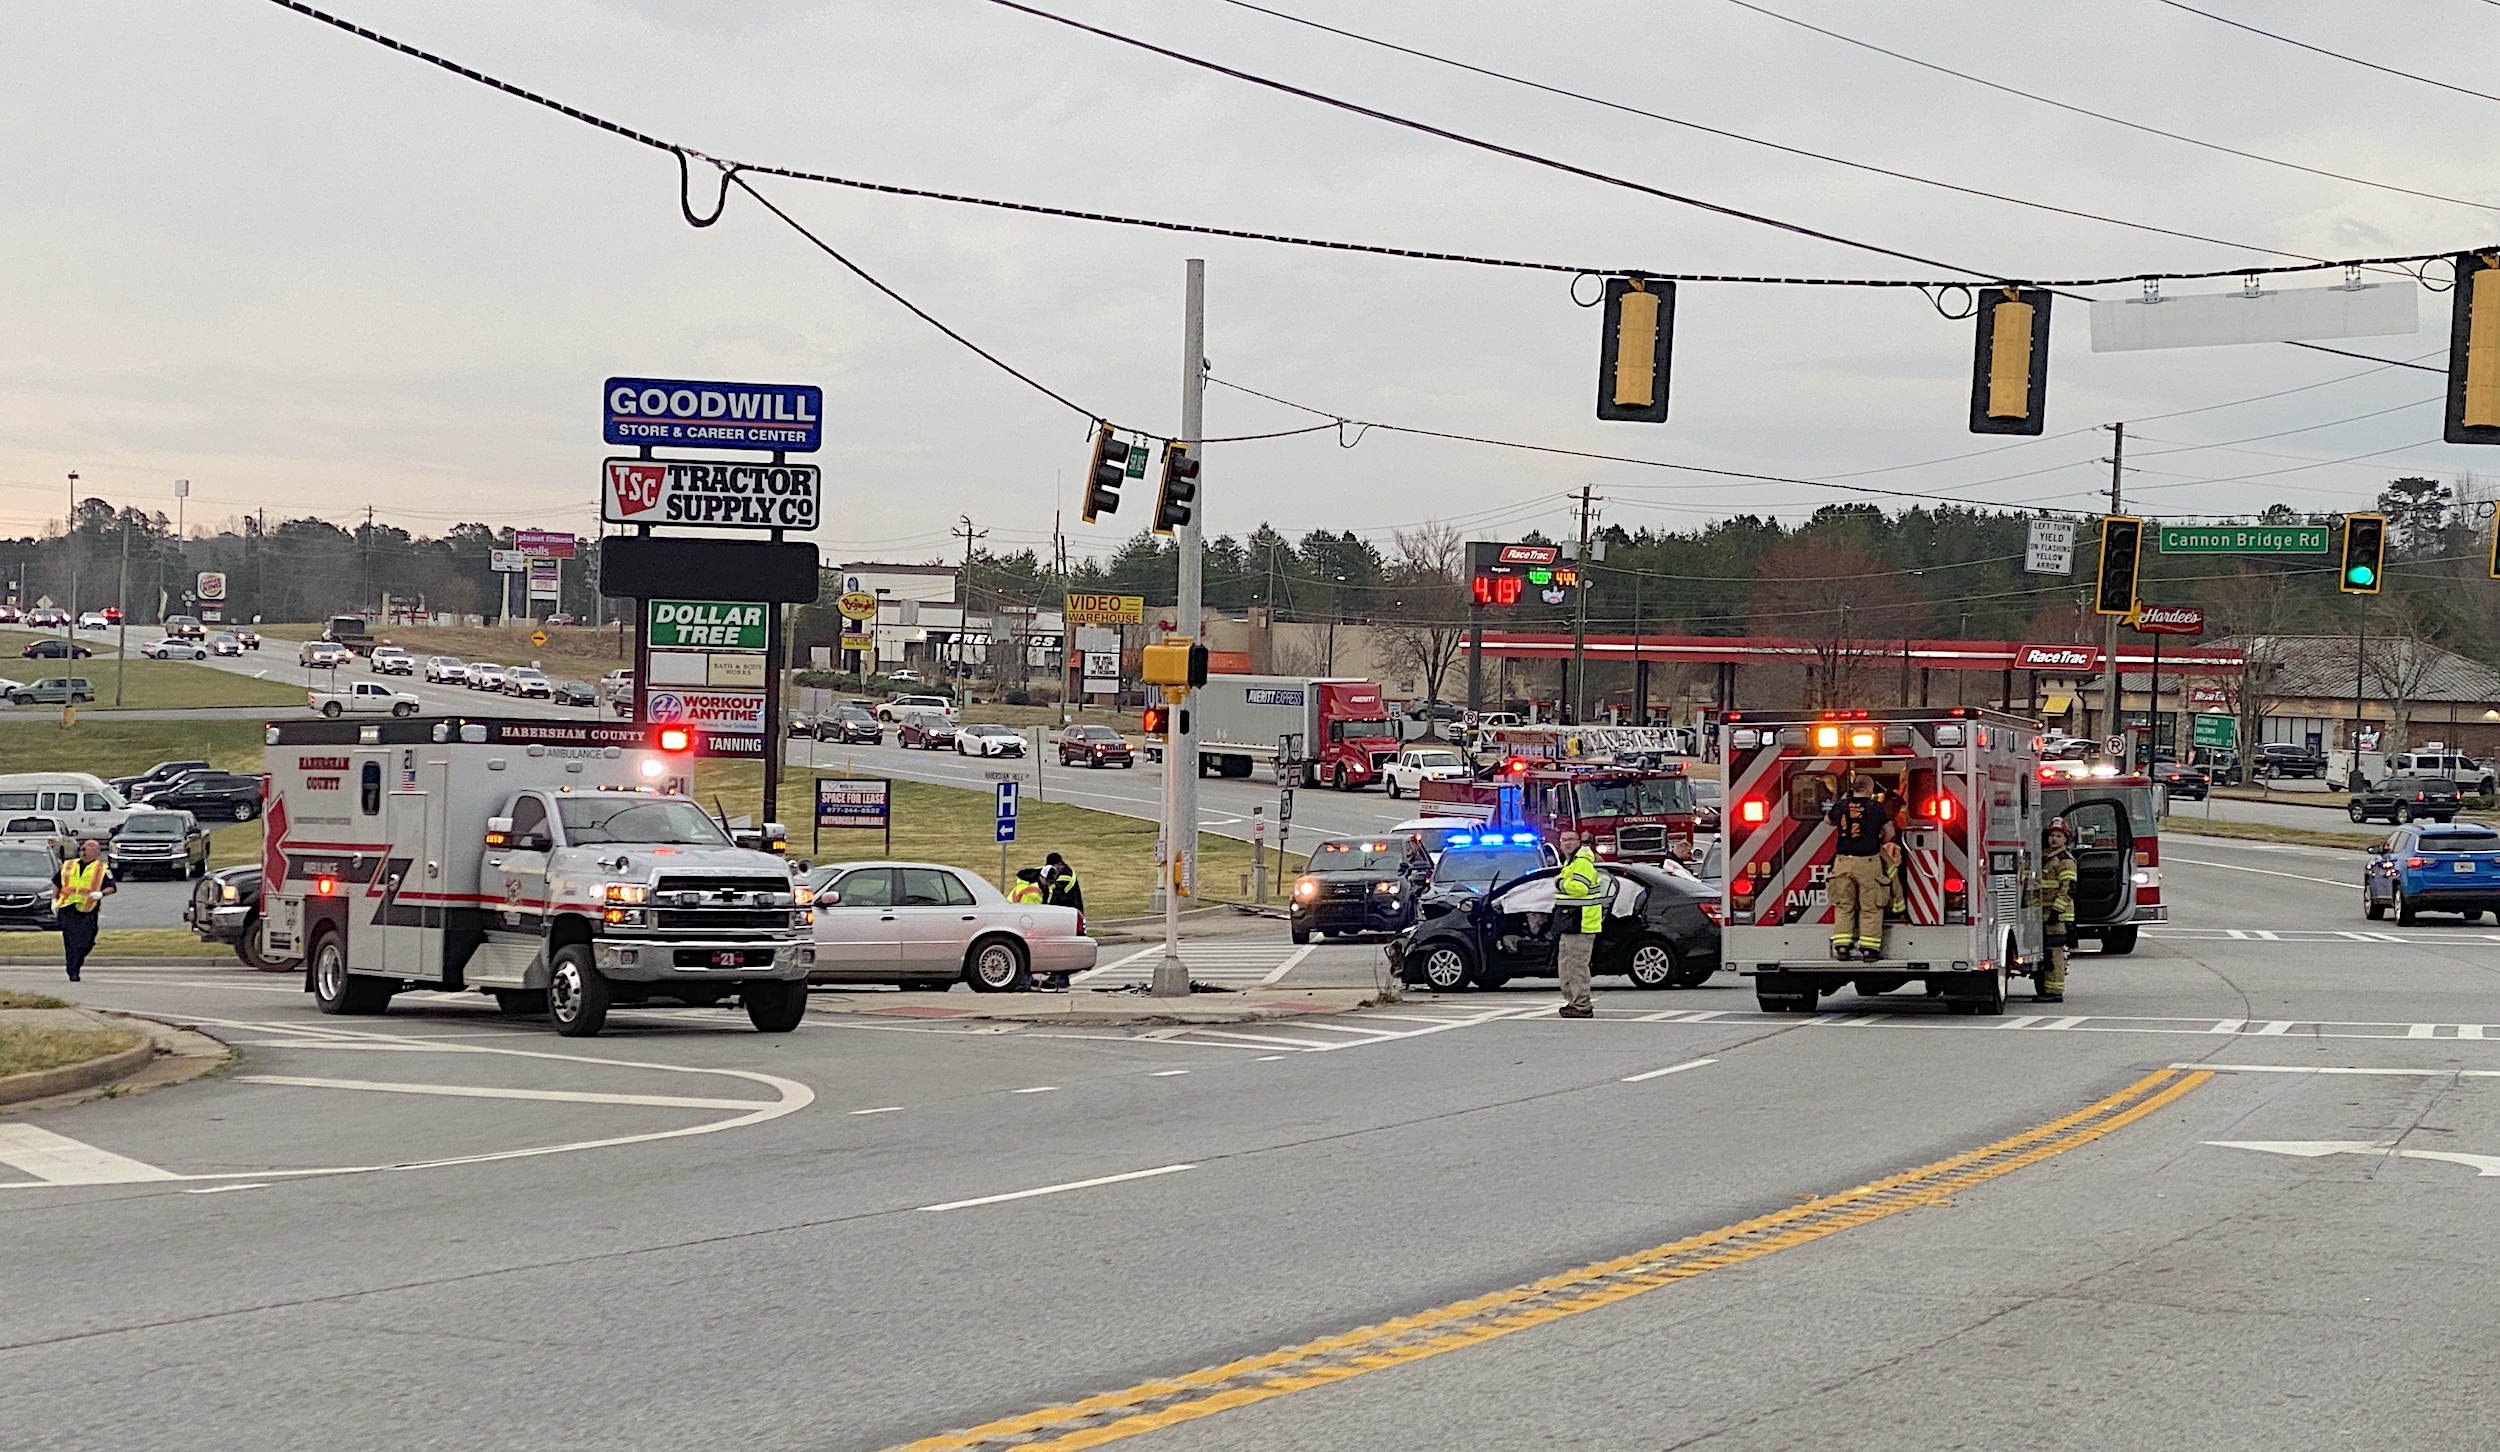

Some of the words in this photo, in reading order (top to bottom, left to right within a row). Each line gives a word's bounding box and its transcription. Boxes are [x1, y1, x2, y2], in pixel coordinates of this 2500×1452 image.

[610, 386, 817, 422] GOODWILL
[618, 424, 669, 437] STORE
[672, 425, 683, 438] &
[686, 426, 745, 440] CAREER
[748, 428, 807, 442] CENTER
[615, 466, 657, 508] TSC
[667, 464, 813, 496] TRACTOR
[666, 494, 777, 523] SUPPLY
[2034, 522, 2050, 530] LEFT
[2053, 523, 2071, 531] TURN
[517, 533, 544, 543] planet
[546, 535, 573, 544] fitness
[2040, 532, 2064, 543] YIELD
[2168, 533, 2231, 547] Cannon
[2236, 532, 2293, 550] Bridge
[2299, 533, 2320, 547] Rd
[1507, 549, 1549, 560] RaceTrac
[2036, 552, 2063, 561] YELLOW
[2036, 561, 2061, 570] ARROW
[1069, 595, 1121, 611] VIDEO
[656, 604, 762, 626] DOLLAR
[1068, 612, 1139, 624] WAREHOUSE
[2139, 608, 2202, 624] Hardee's
[676, 624, 741, 645] TREE
[2027, 650, 2087, 664] RaceTrac
[683, 696, 763, 710] WORKOUT
[1248, 690, 1275, 703] AVERITT
[1275, 691, 1302, 705] EXPRESS
[688, 708, 758, 722] ANYTIME
[502, 726, 586, 739] HABERSHAM
[591, 730, 645, 741] COUNTY
[708, 737, 762, 752] TANNING
[547, 748, 602, 759] AMBULANCE
[821, 792, 846, 803] SPACE
[847, 793, 861, 804] FOR
[862, 794, 885, 804] LEASE
[998, 784, 1016, 816] H
[720, 952, 736, 966] 21
